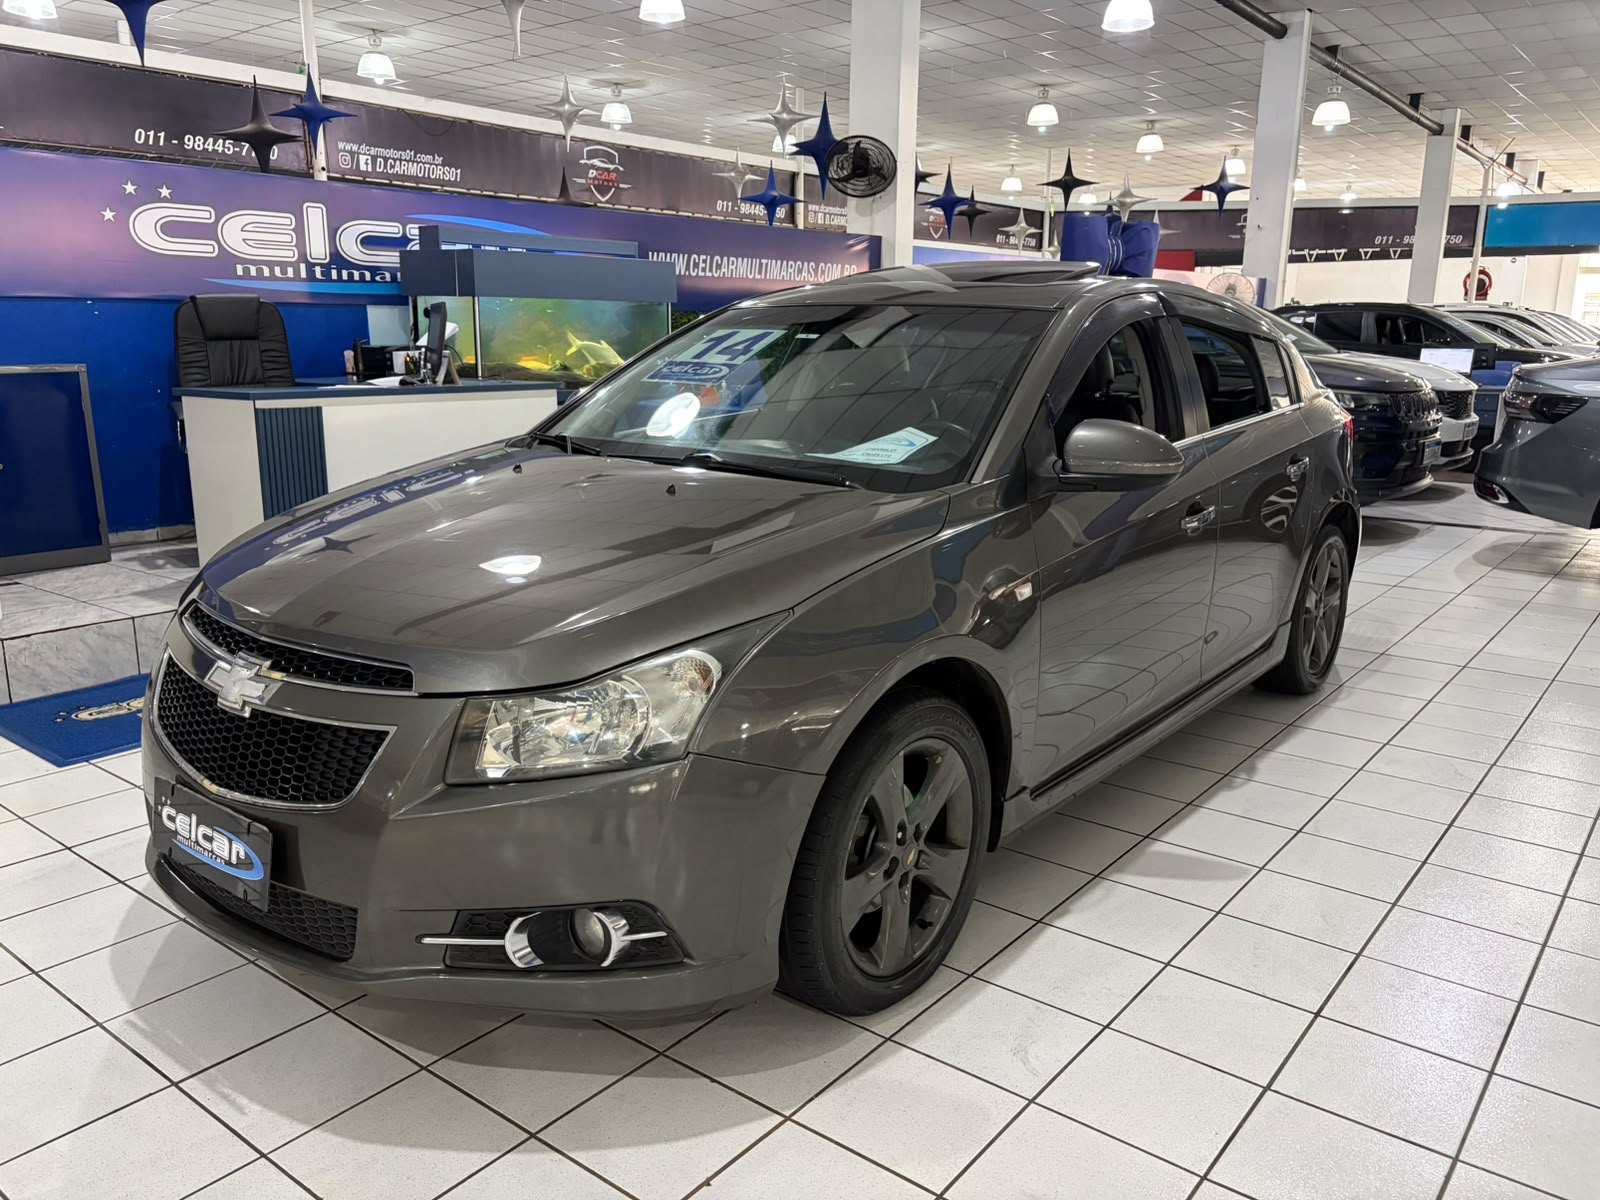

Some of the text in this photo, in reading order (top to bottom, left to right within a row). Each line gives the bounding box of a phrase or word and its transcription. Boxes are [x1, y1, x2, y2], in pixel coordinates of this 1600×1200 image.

[134, 128, 166, 146] 011
[183, 134, 278, 160] 98445-70
[337, 140, 444, 165] www.dcarmotors01.com.br
[376, 157, 461, 182] D.CARMOTORS01
[716, 200, 732, 212] 011
[740, 203, 785, 219] 98445-50
[130, 202, 420, 268] celc
[1375, 234, 1393, 245] 011
[235, 262, 401, 282] multima
[692, 331, 774, 361] 14
[661, 363, 720, 375] celcar
[162, 805, 246, 865] celcar
[177, 835, 225, 865] multimarcas
